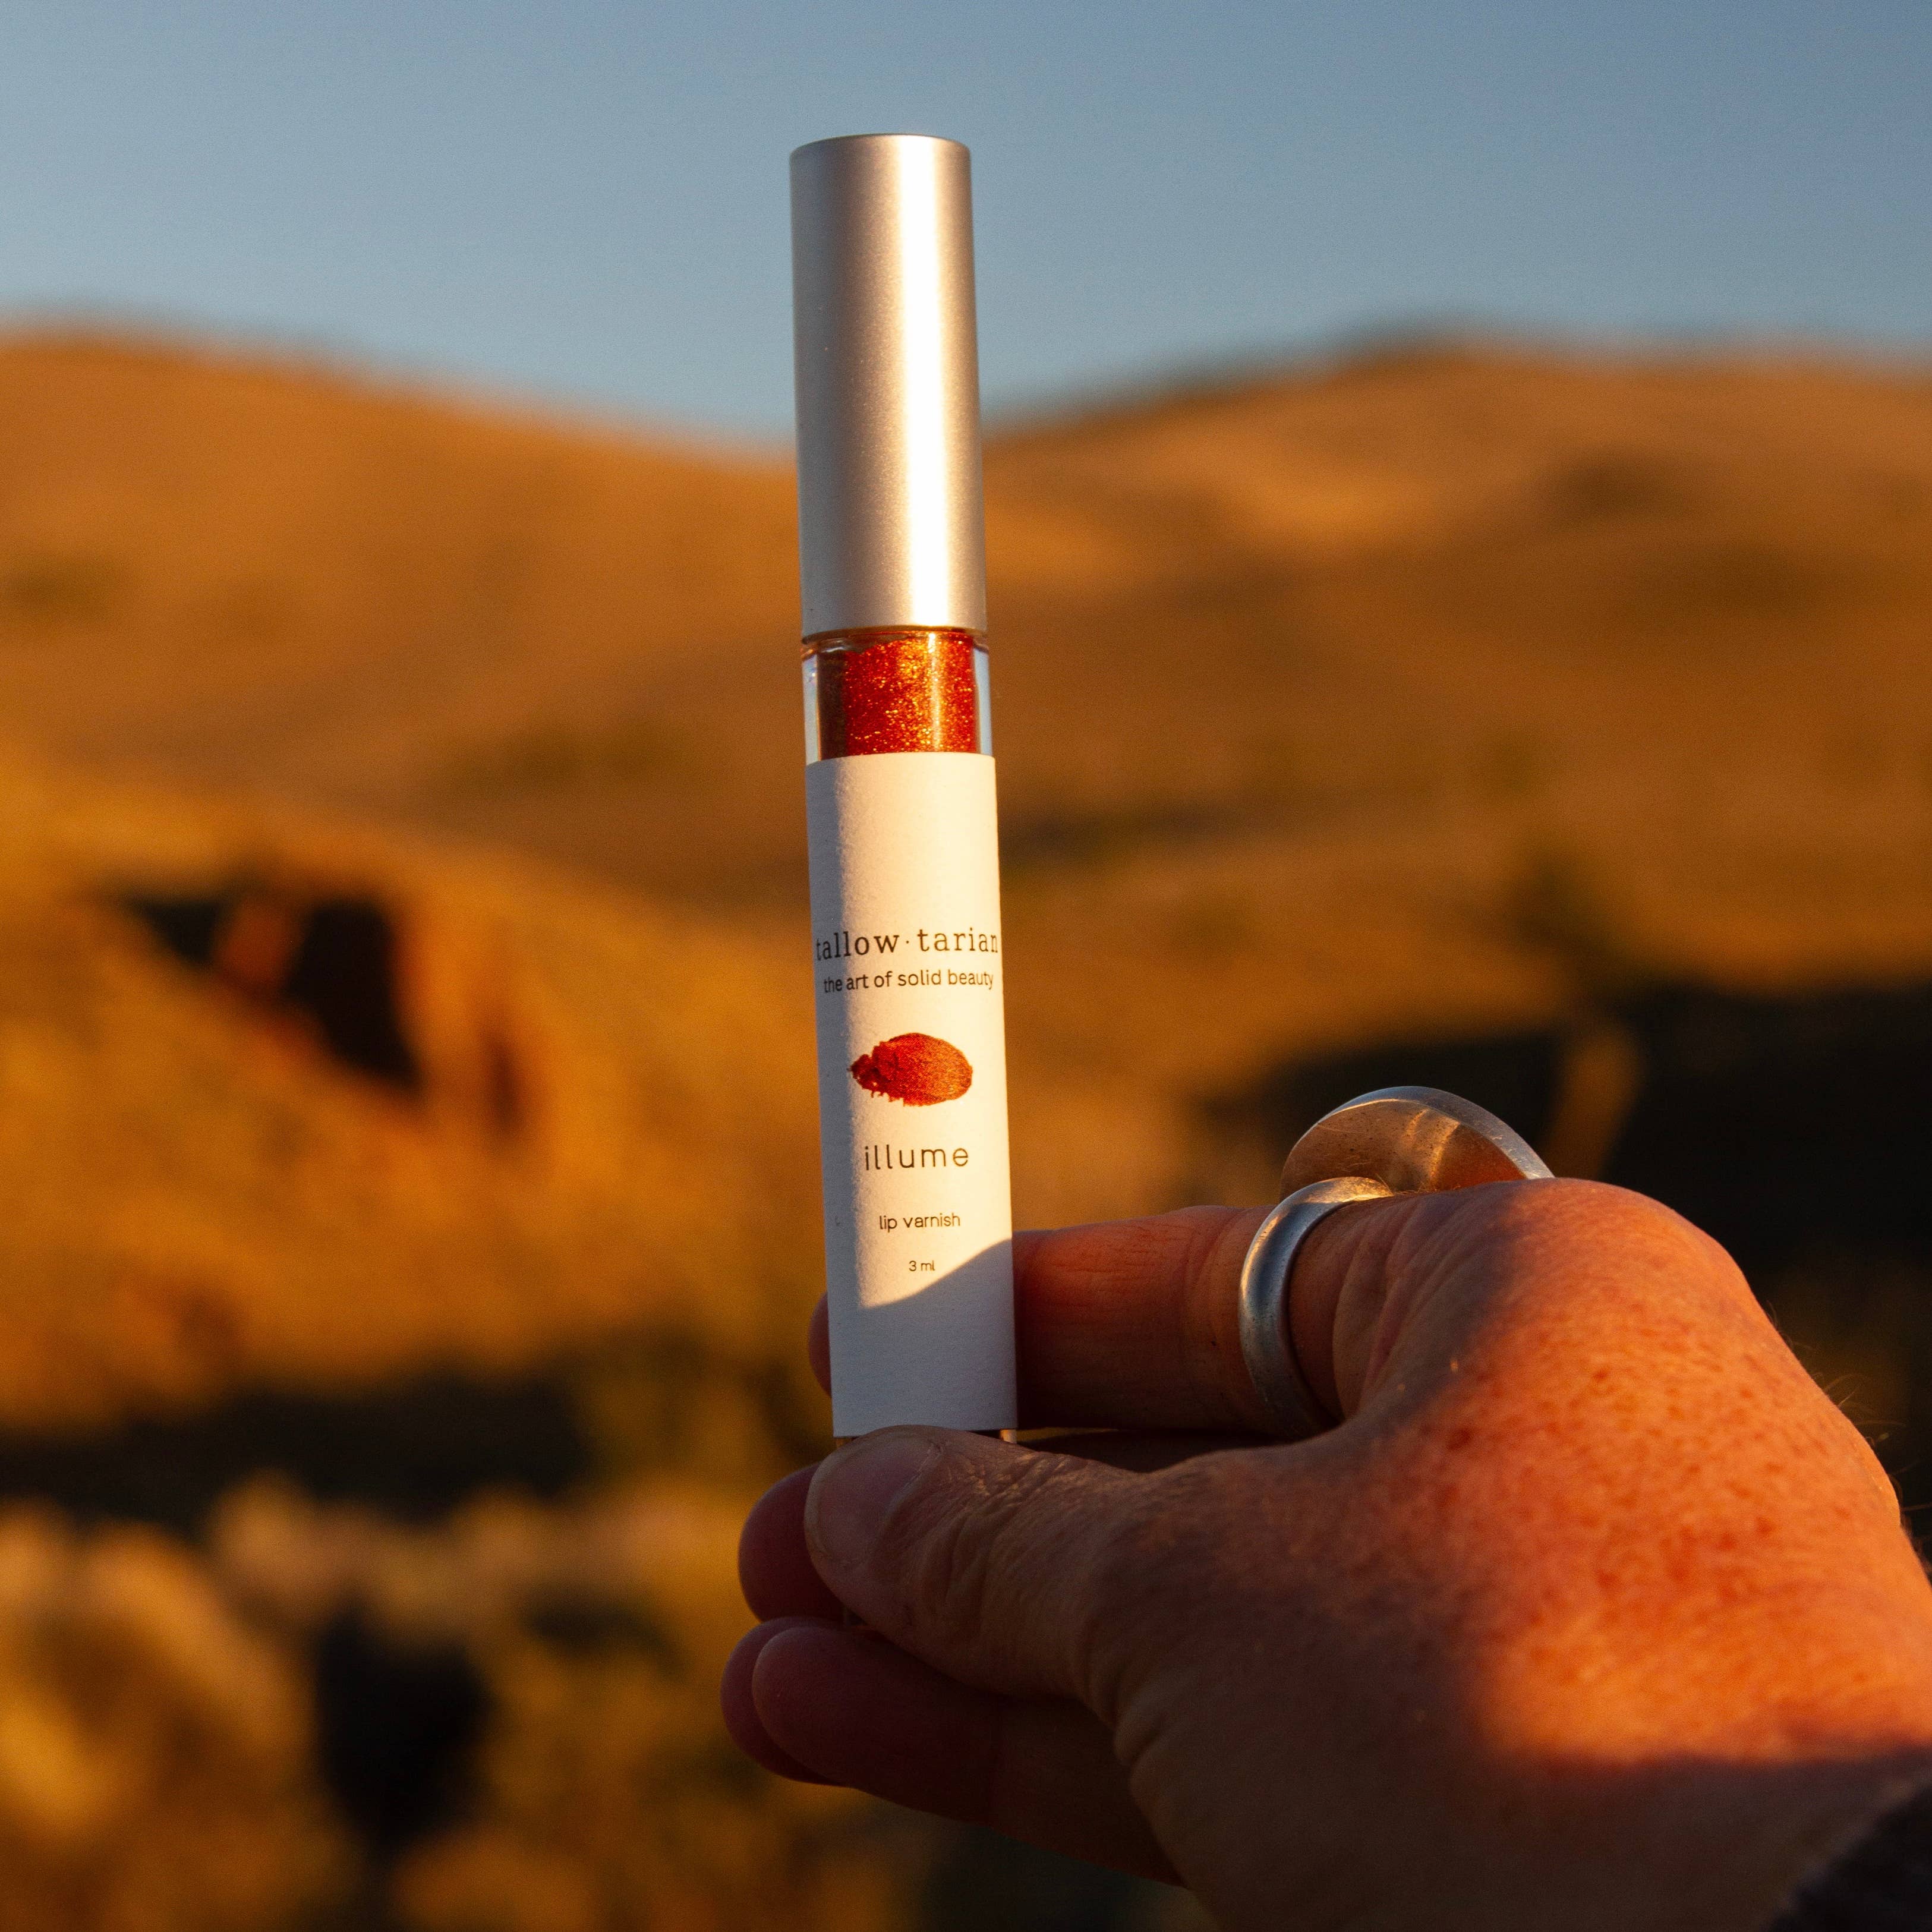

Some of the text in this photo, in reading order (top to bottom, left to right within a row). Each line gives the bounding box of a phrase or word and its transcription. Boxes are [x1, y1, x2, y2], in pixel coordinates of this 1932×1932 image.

[824, 969, 993, 993] the art of solid beauty
[864, 1144, 969, 1171] illume
[879, 1213, 960, 1233] lip varnish
[909, 1260, 935, 1272] 3 ml
